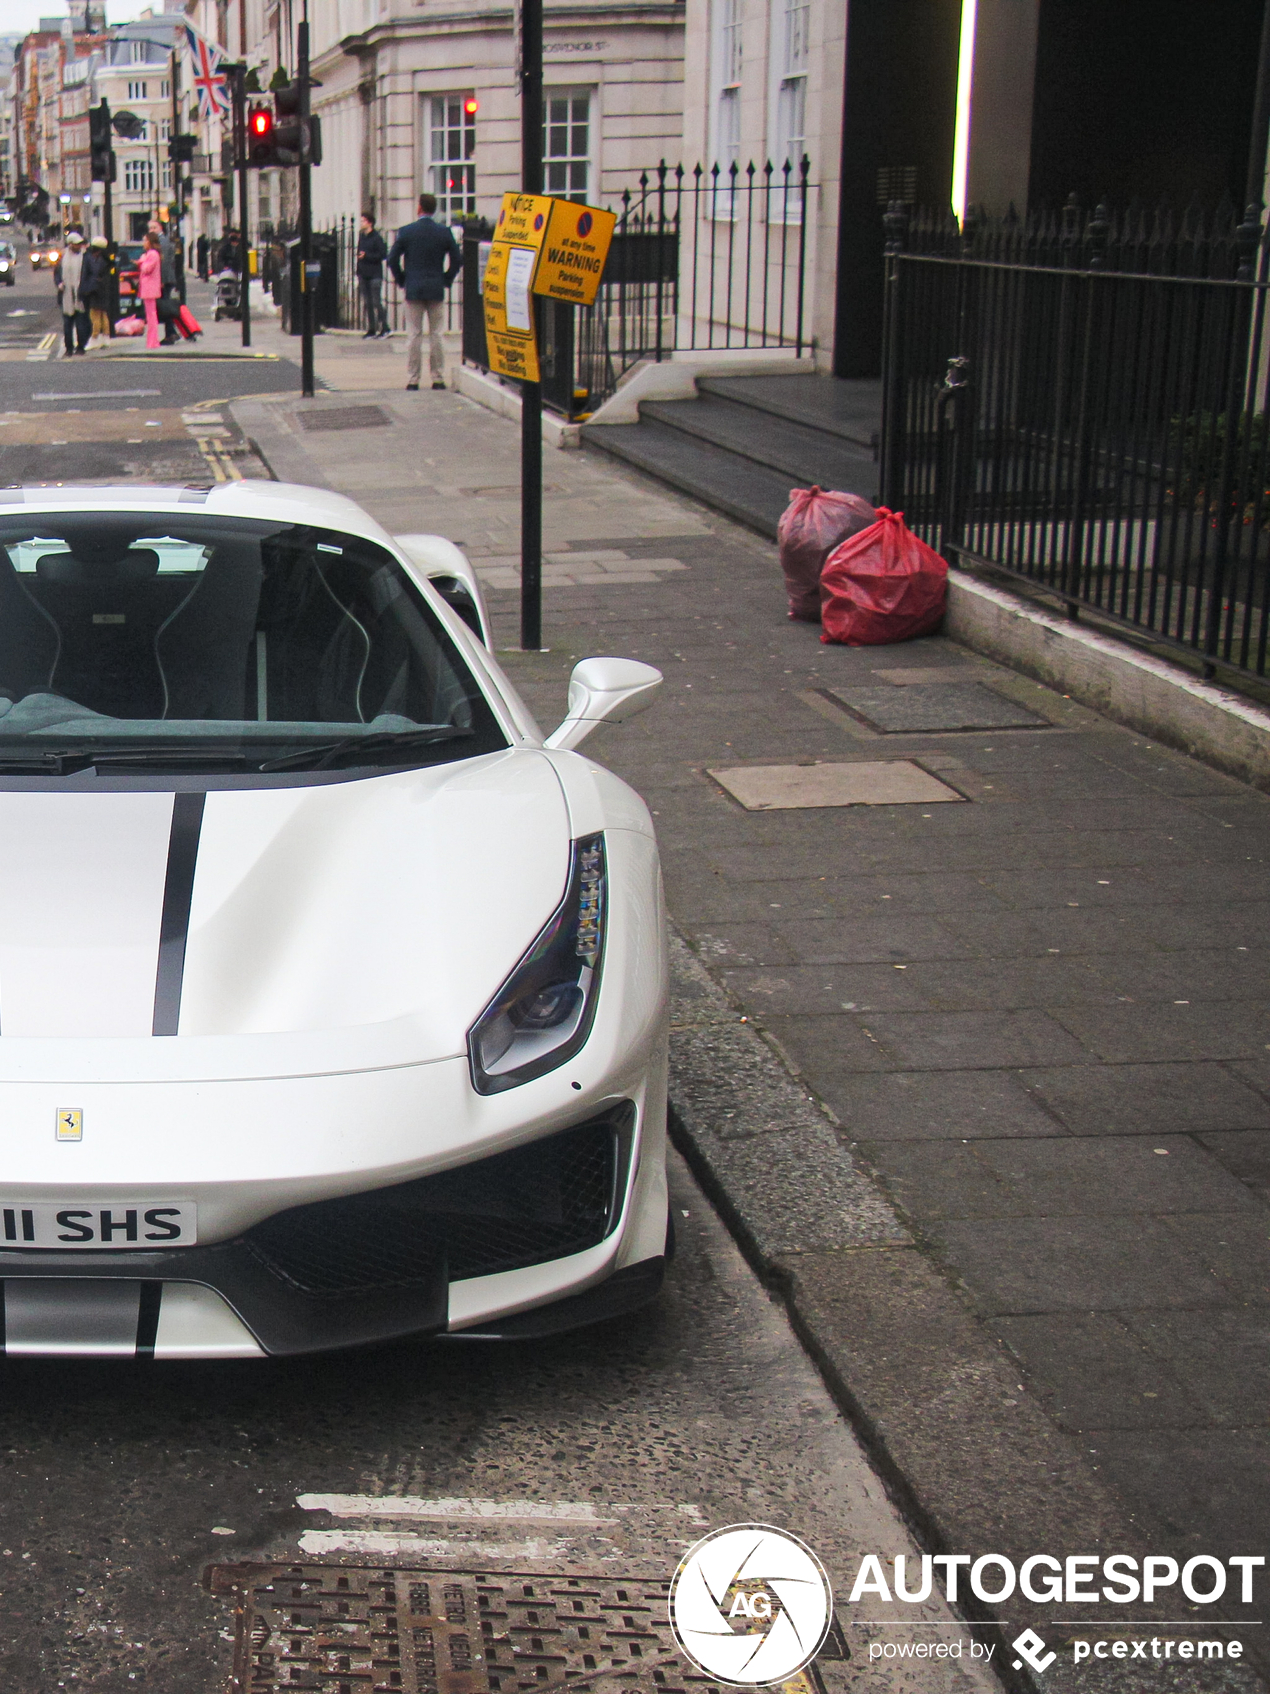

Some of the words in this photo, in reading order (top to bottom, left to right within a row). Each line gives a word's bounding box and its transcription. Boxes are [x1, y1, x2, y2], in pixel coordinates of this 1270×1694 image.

[509, 215, 527, 228] Parking
[502, 228, 530, 241] Suspended
[562, 238, 569, 246] at
[570, 240, 582, 250] any
[583, 242, 596, 253] time
[548, 248, 601, 273] WARNING
[558, 270, 584, 287] Parking
[549, 284, 585, 299] suspension
[56, 1207, 182, 1242] SHS
[409, 1581, 431, 1615] FIBRE
[443, 1583, 466, 1623] METRO
[448, 1633, 472, 1671] MEDIA
